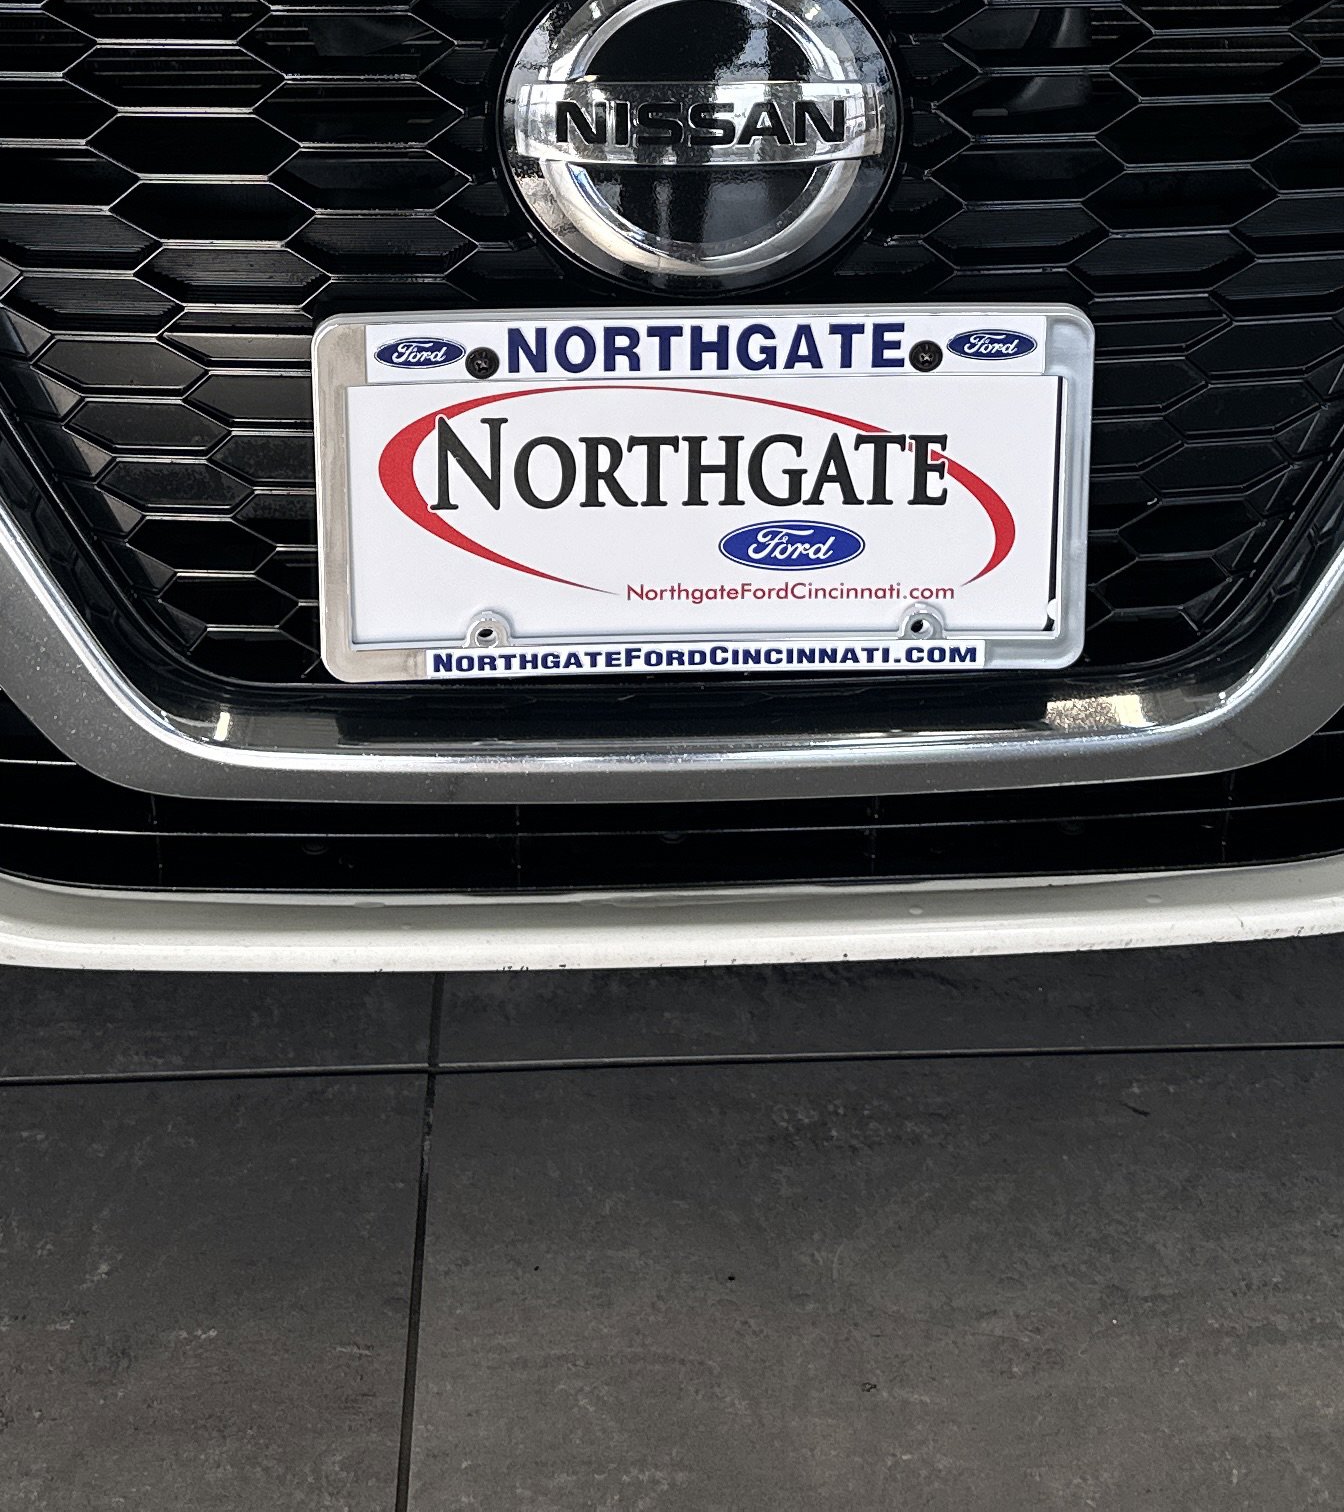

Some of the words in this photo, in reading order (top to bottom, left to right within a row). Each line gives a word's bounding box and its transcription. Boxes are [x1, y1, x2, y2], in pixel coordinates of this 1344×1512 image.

[556, 99, 846, 148] NISSAN
[389, 340, 449, 365] Ford
[507, 321, 905, 374] NORTHGATE
[961, 332, 1022, 357] Ford
[430, 417, 949, 510] NORTHGATE
[744, 523, 838, 564] Ford
[626, 581, 955, 605] NorthgateFordCincinnati.com
[431, 645, 978, 674] NORTHGATEFORDCINCINNATI.COM
